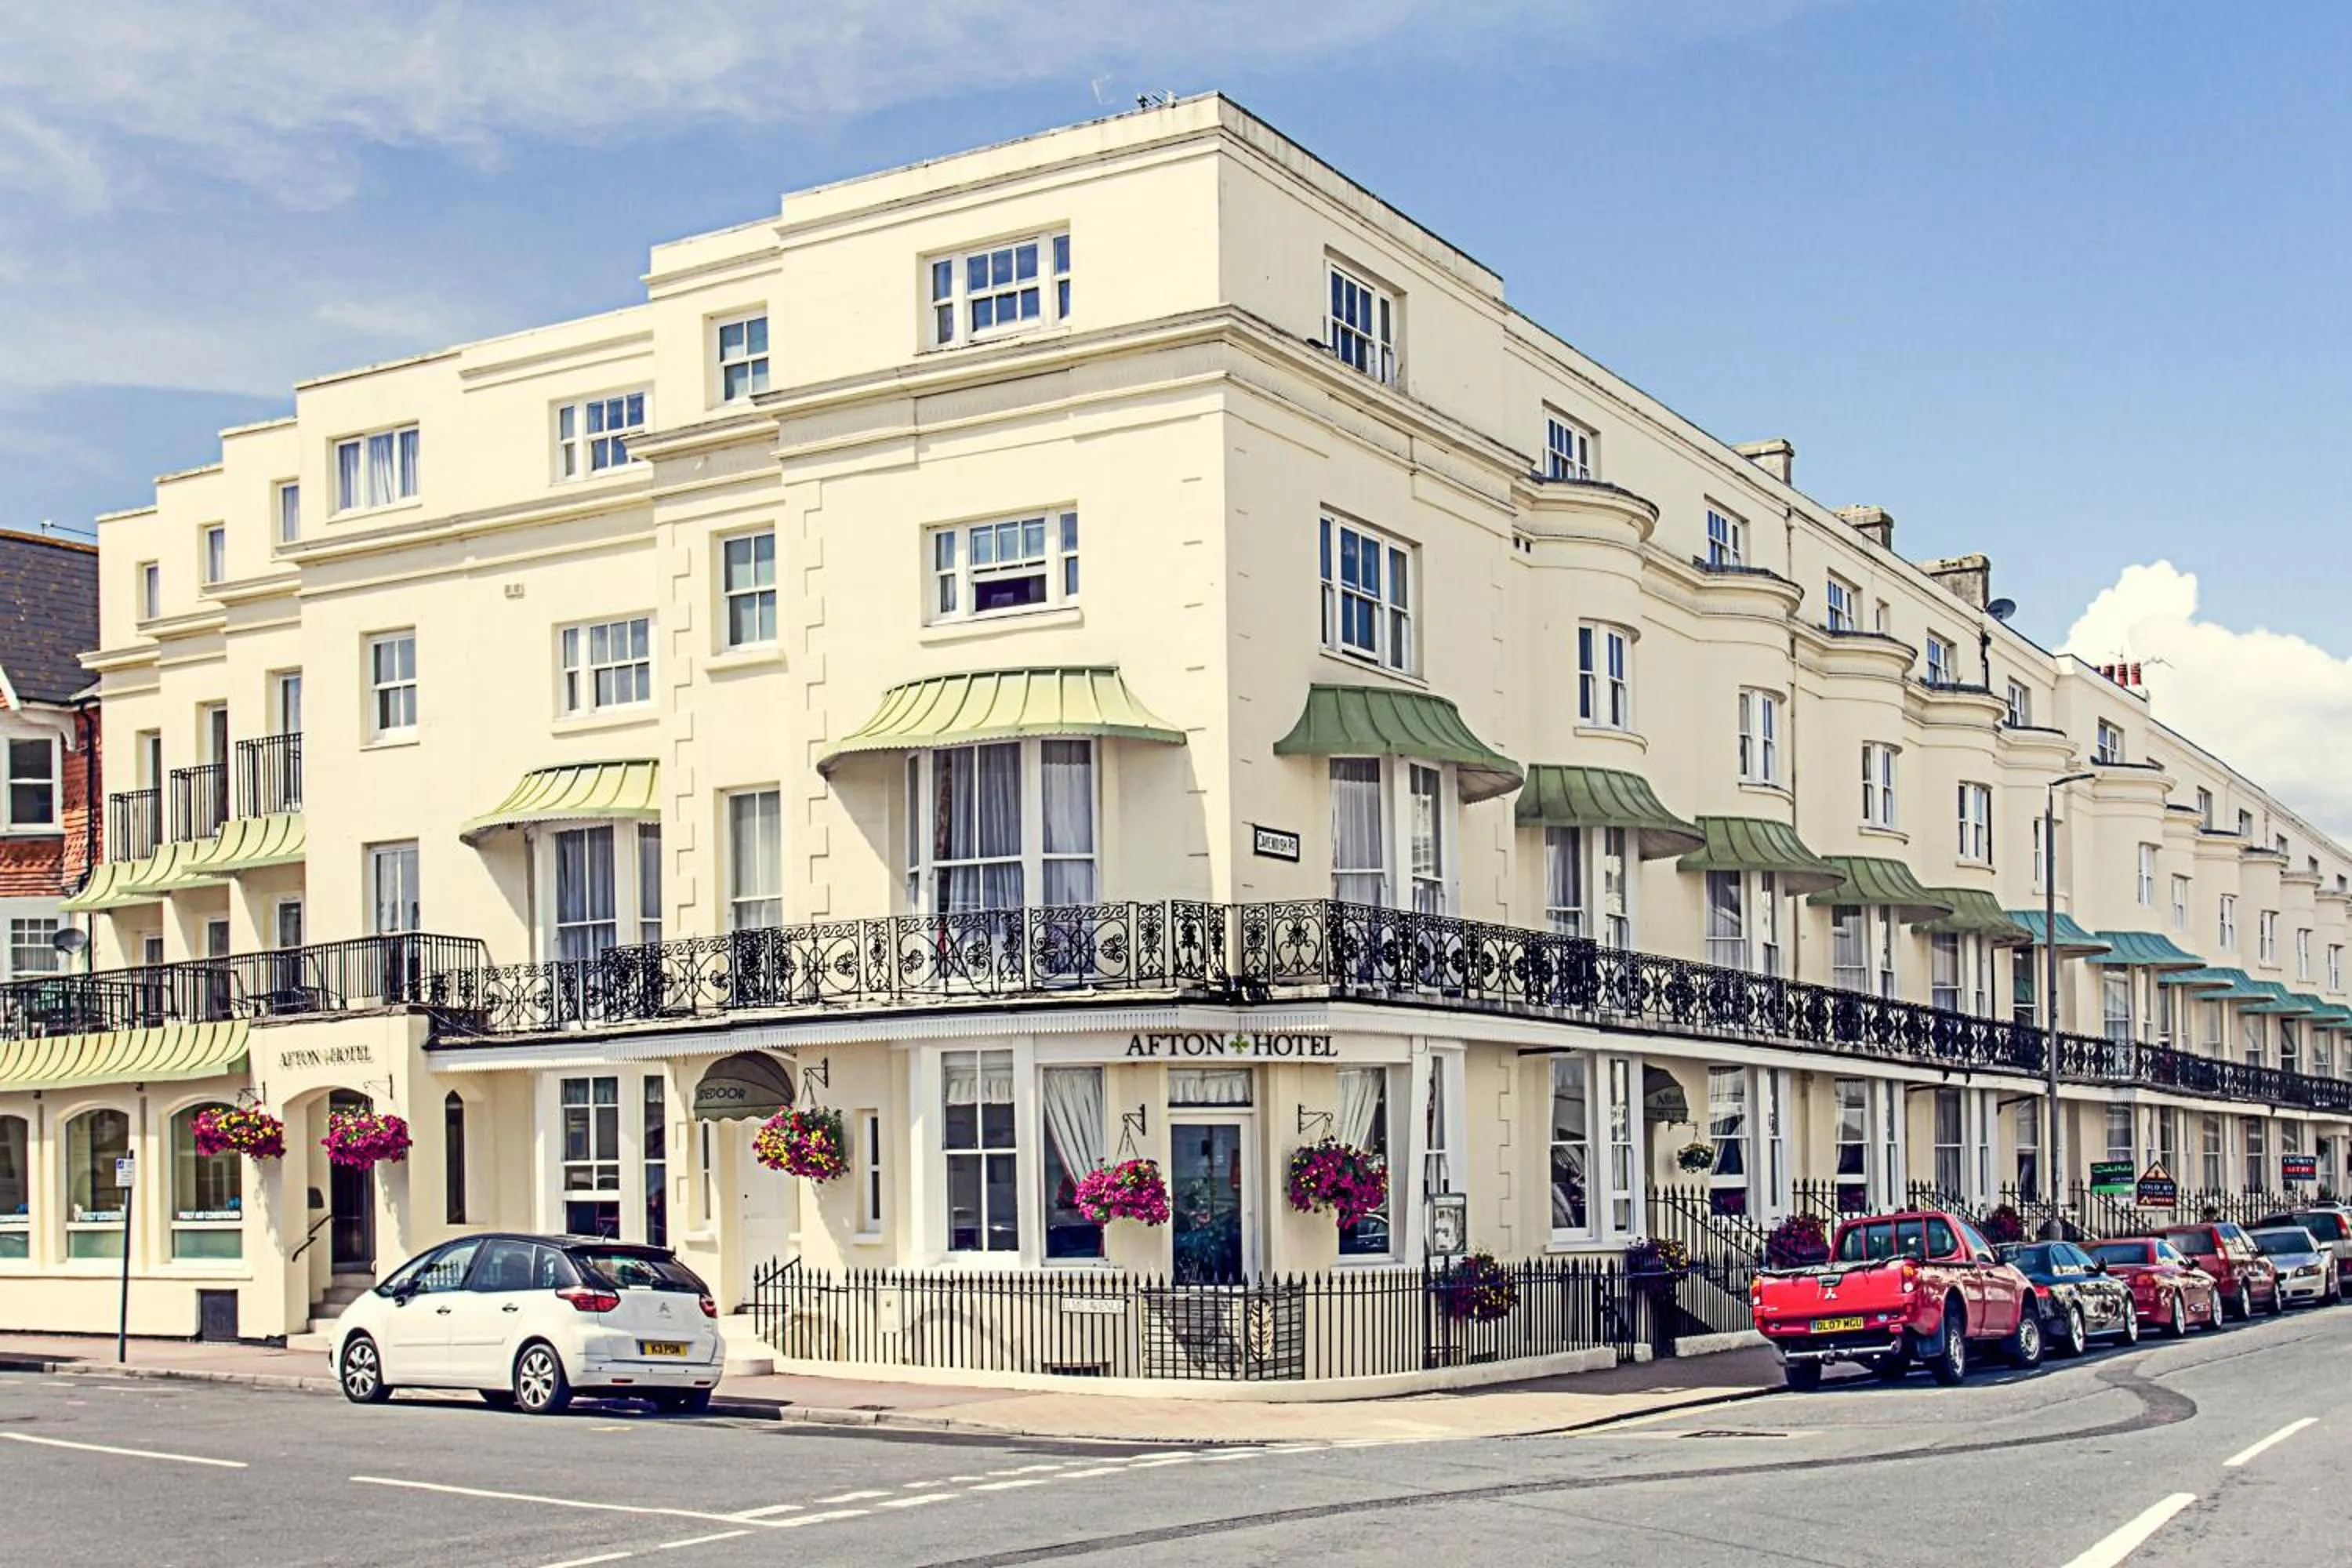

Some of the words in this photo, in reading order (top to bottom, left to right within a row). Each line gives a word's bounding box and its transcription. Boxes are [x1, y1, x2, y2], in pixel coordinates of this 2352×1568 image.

[329, 1044, 374, 1065] HOTEL
[1126, 1033, 1225, 1056] AFTON
[1253, 1033, 1338, 1057] HOTEL
